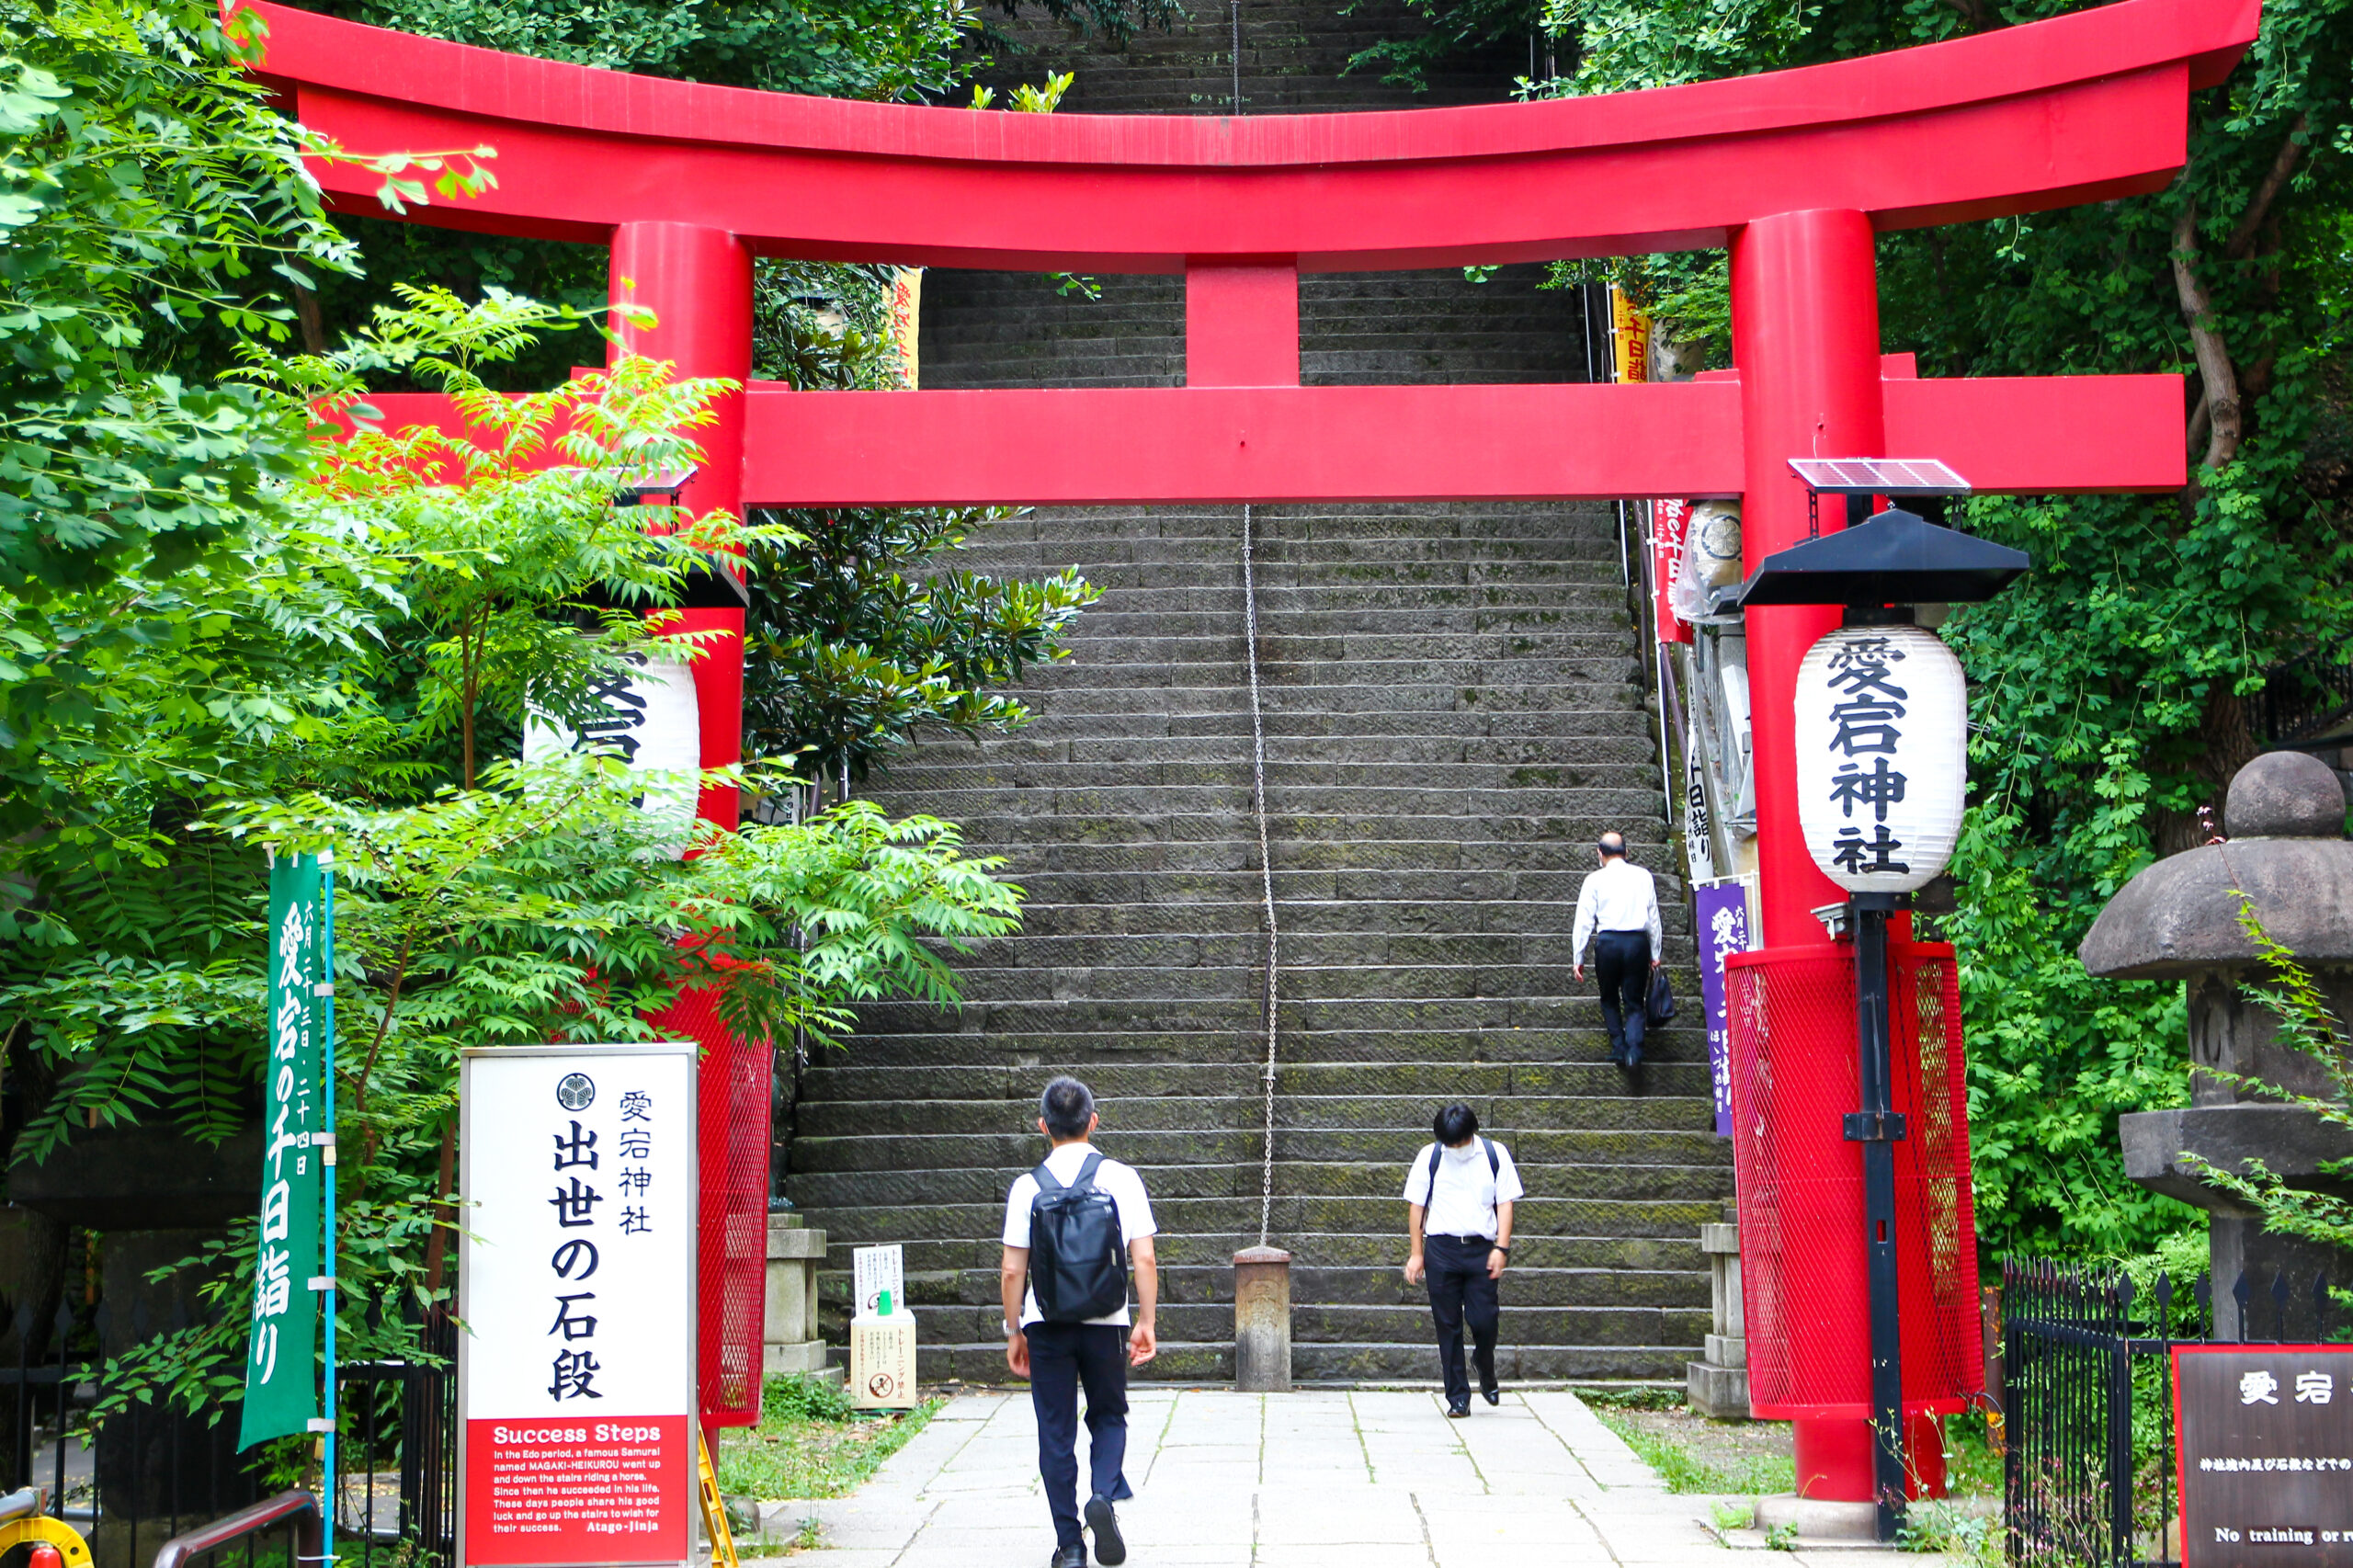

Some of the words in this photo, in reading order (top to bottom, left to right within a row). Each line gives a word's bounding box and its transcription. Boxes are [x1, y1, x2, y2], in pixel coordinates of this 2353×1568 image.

[1827, 637, 1910, 875] 愛宕神社
[256, 902, 303, 1385] 愛宕の千日詣り
[618, 1090, 654, 1236] 愛宕神社
[548, 1120, 604, 1403] 出世の石段
[2240, 1370, 2353, 1404] 愛宕
[494, 1426, 586, 1444] Success
[595, 1424, 661, 1444] Steps
[494, 1450, 503, 1460] In
[506, 1450, 520, 1459] the
[522, 1450, 540, 1459] Edo
[541, 1449, 574, 1459] period,
[584, 1449, 619, 1457] famous
[621, 1447, 660, 1457] Samurai
[494, 1462, 526, 1471] named
[529, 1460, 619, 1471] MAGAKI-HEIKUROU
[622, 1460, 646, 1469] went
[649, 1460, 661, 1470] up
[494, 1474, 511, 1483] and
[513, 1474, 537, 1483] down
[540, 1473, 554, 1483] the
[557, 1472, 582, 1483] stairs
[584, 1472, 609, 1483] riding
[620, 1472, 646, 1482] horse.
[494, 1487, 519, 1496] Since
[523, 1486, 544, 1495] then
[547, 1486, 558, 1494] he
[562, 1484, 611, 1494] succeeded
[614, 1484, 623, 1494] in
[625, 1484, 640, 1493] his
[642, 1483, 660, 1493] life.
[494, 1499, 523, 1508] These
[526, 1498, 549, 1508] days
[551, 1497, 585, 1508] people
[587, 1496, 615, 1506] share
[618, 1495, 632, 1506] his
[635, 1495, 660, 1506] good
[494, 1512, 514, 1521] luck
[516, 1511, 533, 1520] and
[536, 1512, 547, 1521] go
[550, 1512, 561, 1520] up
[563, 1510, 579, 1519] the
[581, 1509, 608, 1518] stairs
[610, 1509, 620, 1518] to
[622, 1508, 643, 1517] wish
[646, 1508, 659, 1517] for
[494, 1524, 517, 1533] their
[520, 1523, 563, 1532] success.
[586, 1520, 659, 1534] Atago-Jinja
[2214, 1528, 2240, 1543] No
[2248, 1528, 2313, 1545] training
[2321, 1530, 2340, 1542] or
